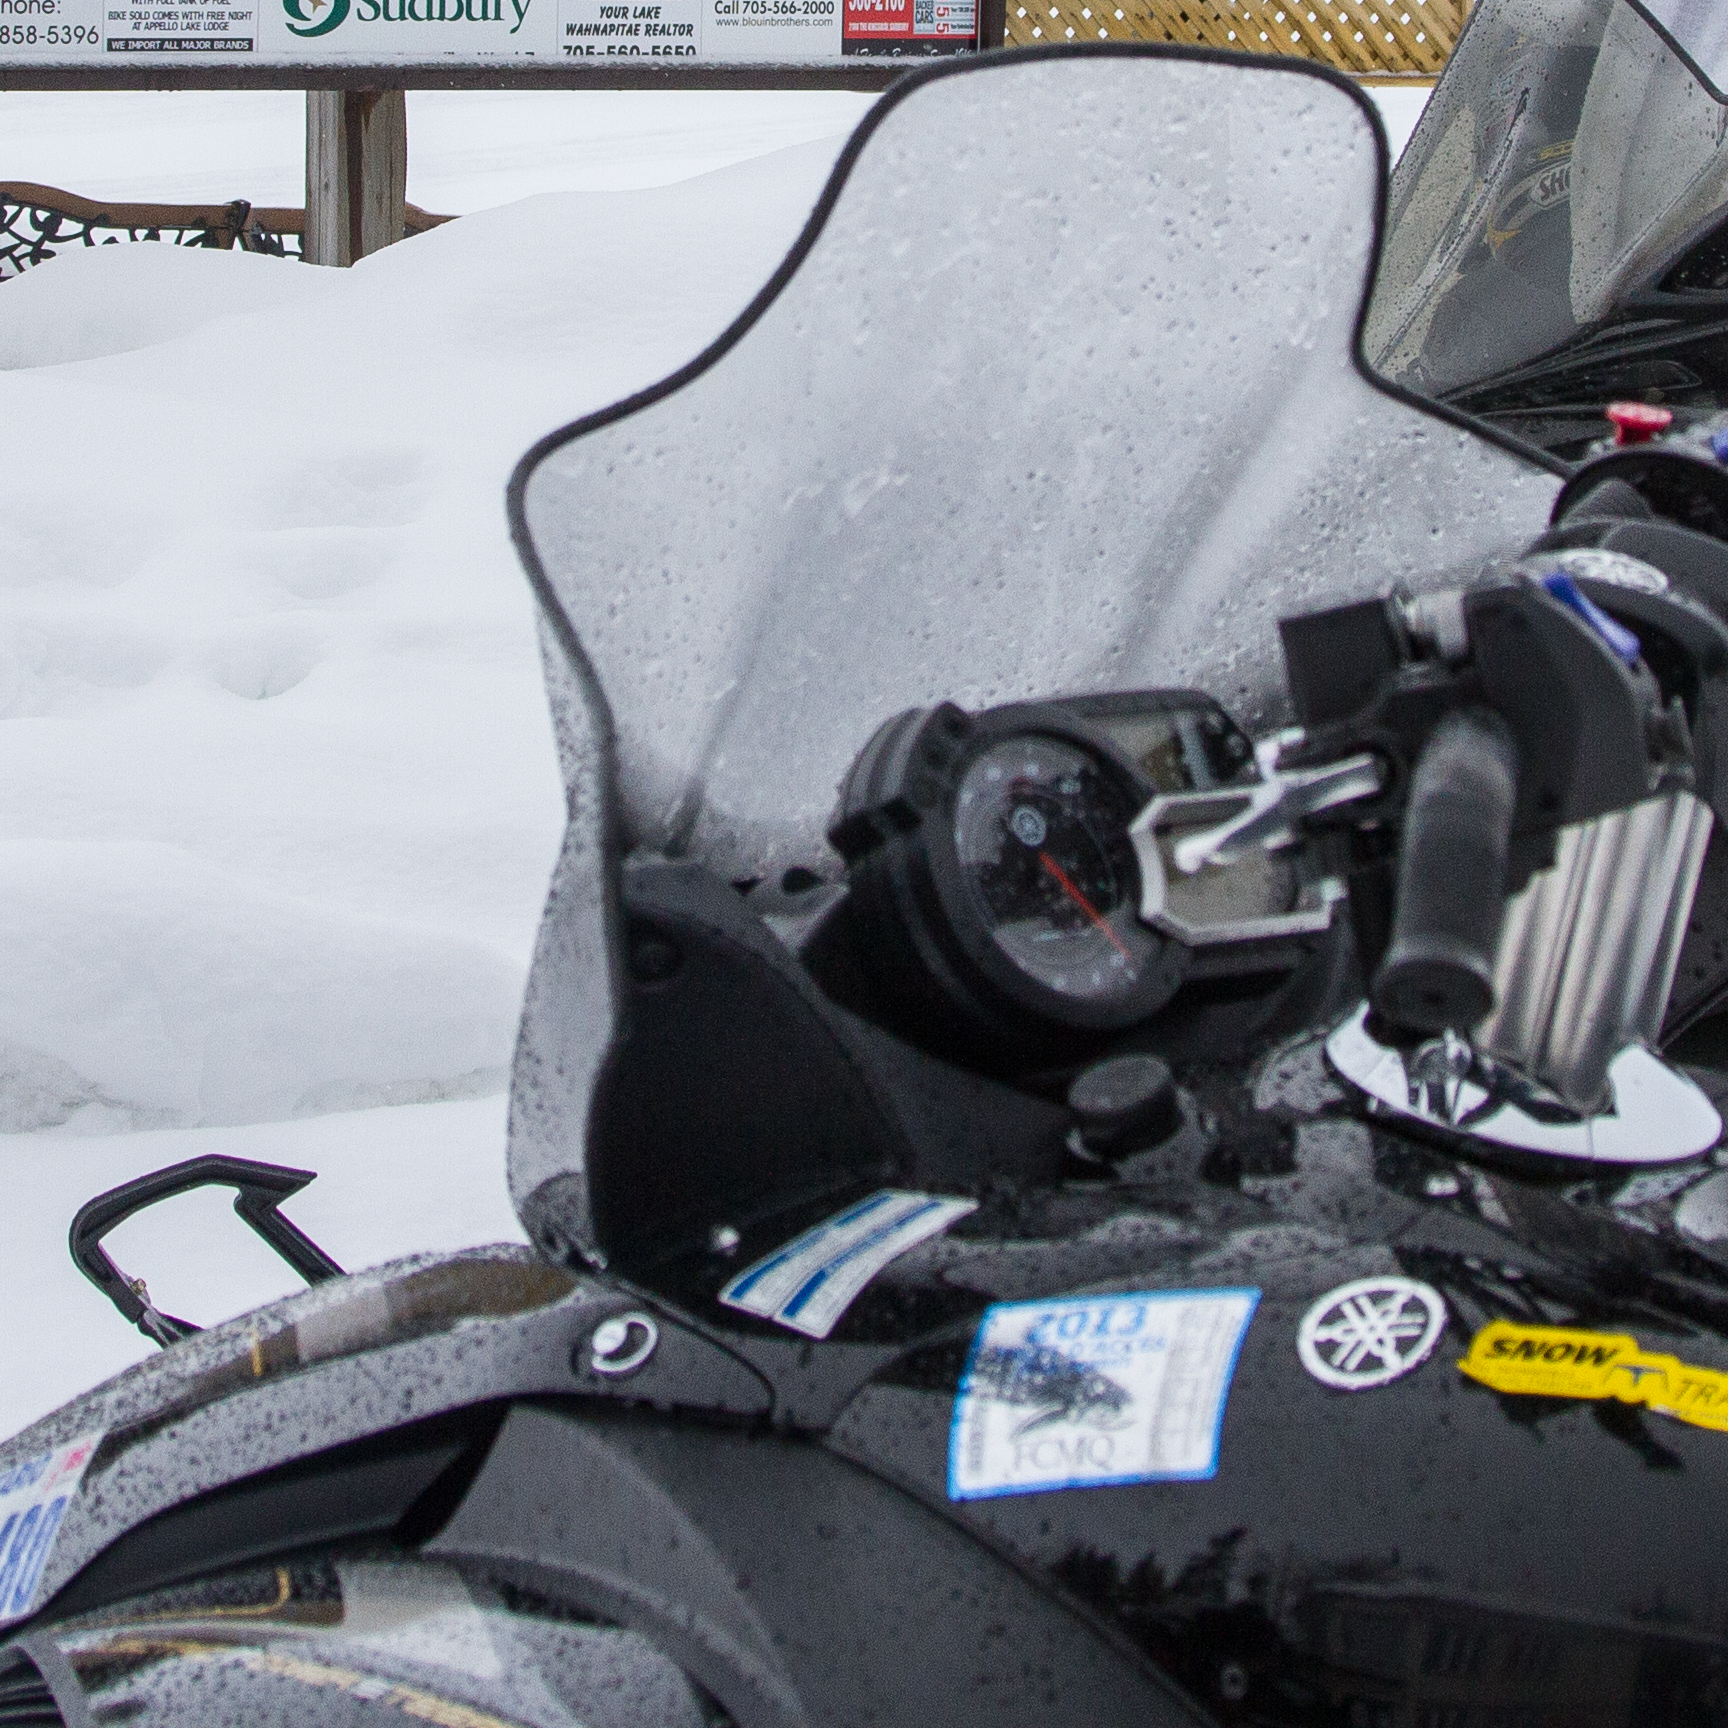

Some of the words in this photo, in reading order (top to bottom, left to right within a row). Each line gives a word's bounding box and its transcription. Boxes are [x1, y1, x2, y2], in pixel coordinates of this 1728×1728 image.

[600, 6, 629, 19] YOUR
[633, 6, 661, 19] LAKE
[715, 0, 739, 14] Call
[743, 1, 835, 14] 705-566-2000
[716, 17, 833, 27] www.blouinbrothers.com
[916, 11, 933, 23] CARS
[566, 24, 640, 36] WAHNAPITAE
[645, 24, 693, 37] REALTOR
[112, 41, 125, 49] WE
[128, 41, 160, 49] IMPORT
[163, 41, 179, 49] ALL
[182, 41, 211, 49] MAJOR
[214, 41, 249, 49] BRANDS
[1486, 1336, 1621, 1367] SNOW
